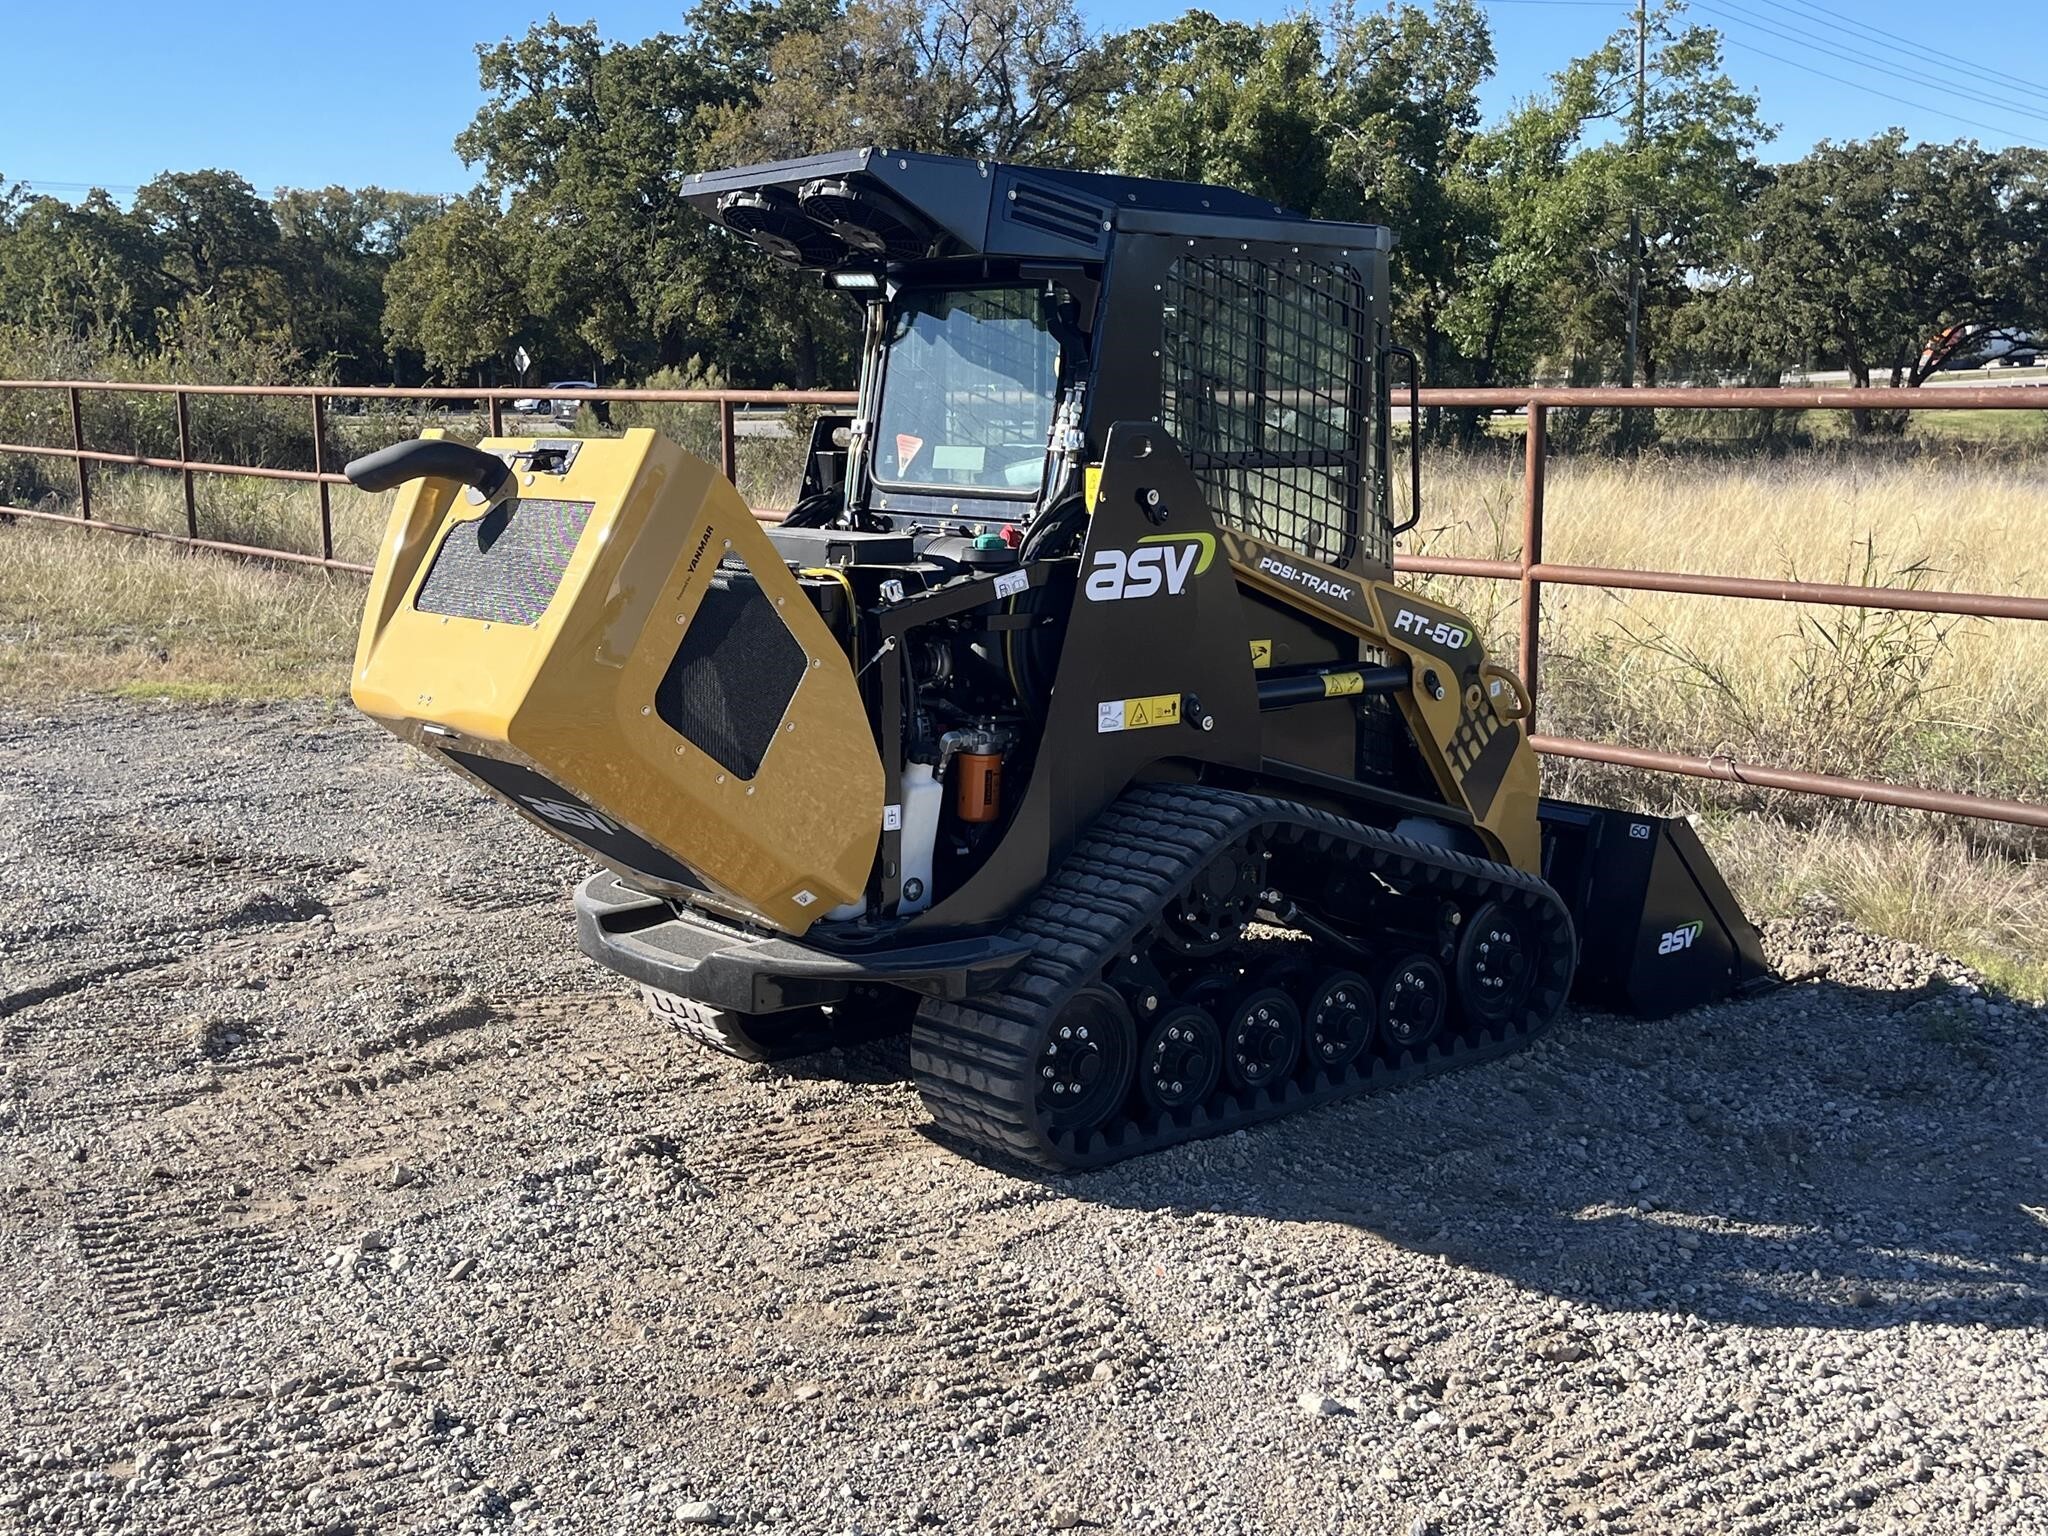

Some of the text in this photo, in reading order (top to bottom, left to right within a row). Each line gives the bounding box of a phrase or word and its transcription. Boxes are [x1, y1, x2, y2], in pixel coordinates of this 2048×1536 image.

[687, 525, 714, 573] YANMAR
[1259, 557, 1351, 601] POSI-TRACK
[1393, 609, 1465, 650] RT-50
[1631, 825, 1648, 838] 60
